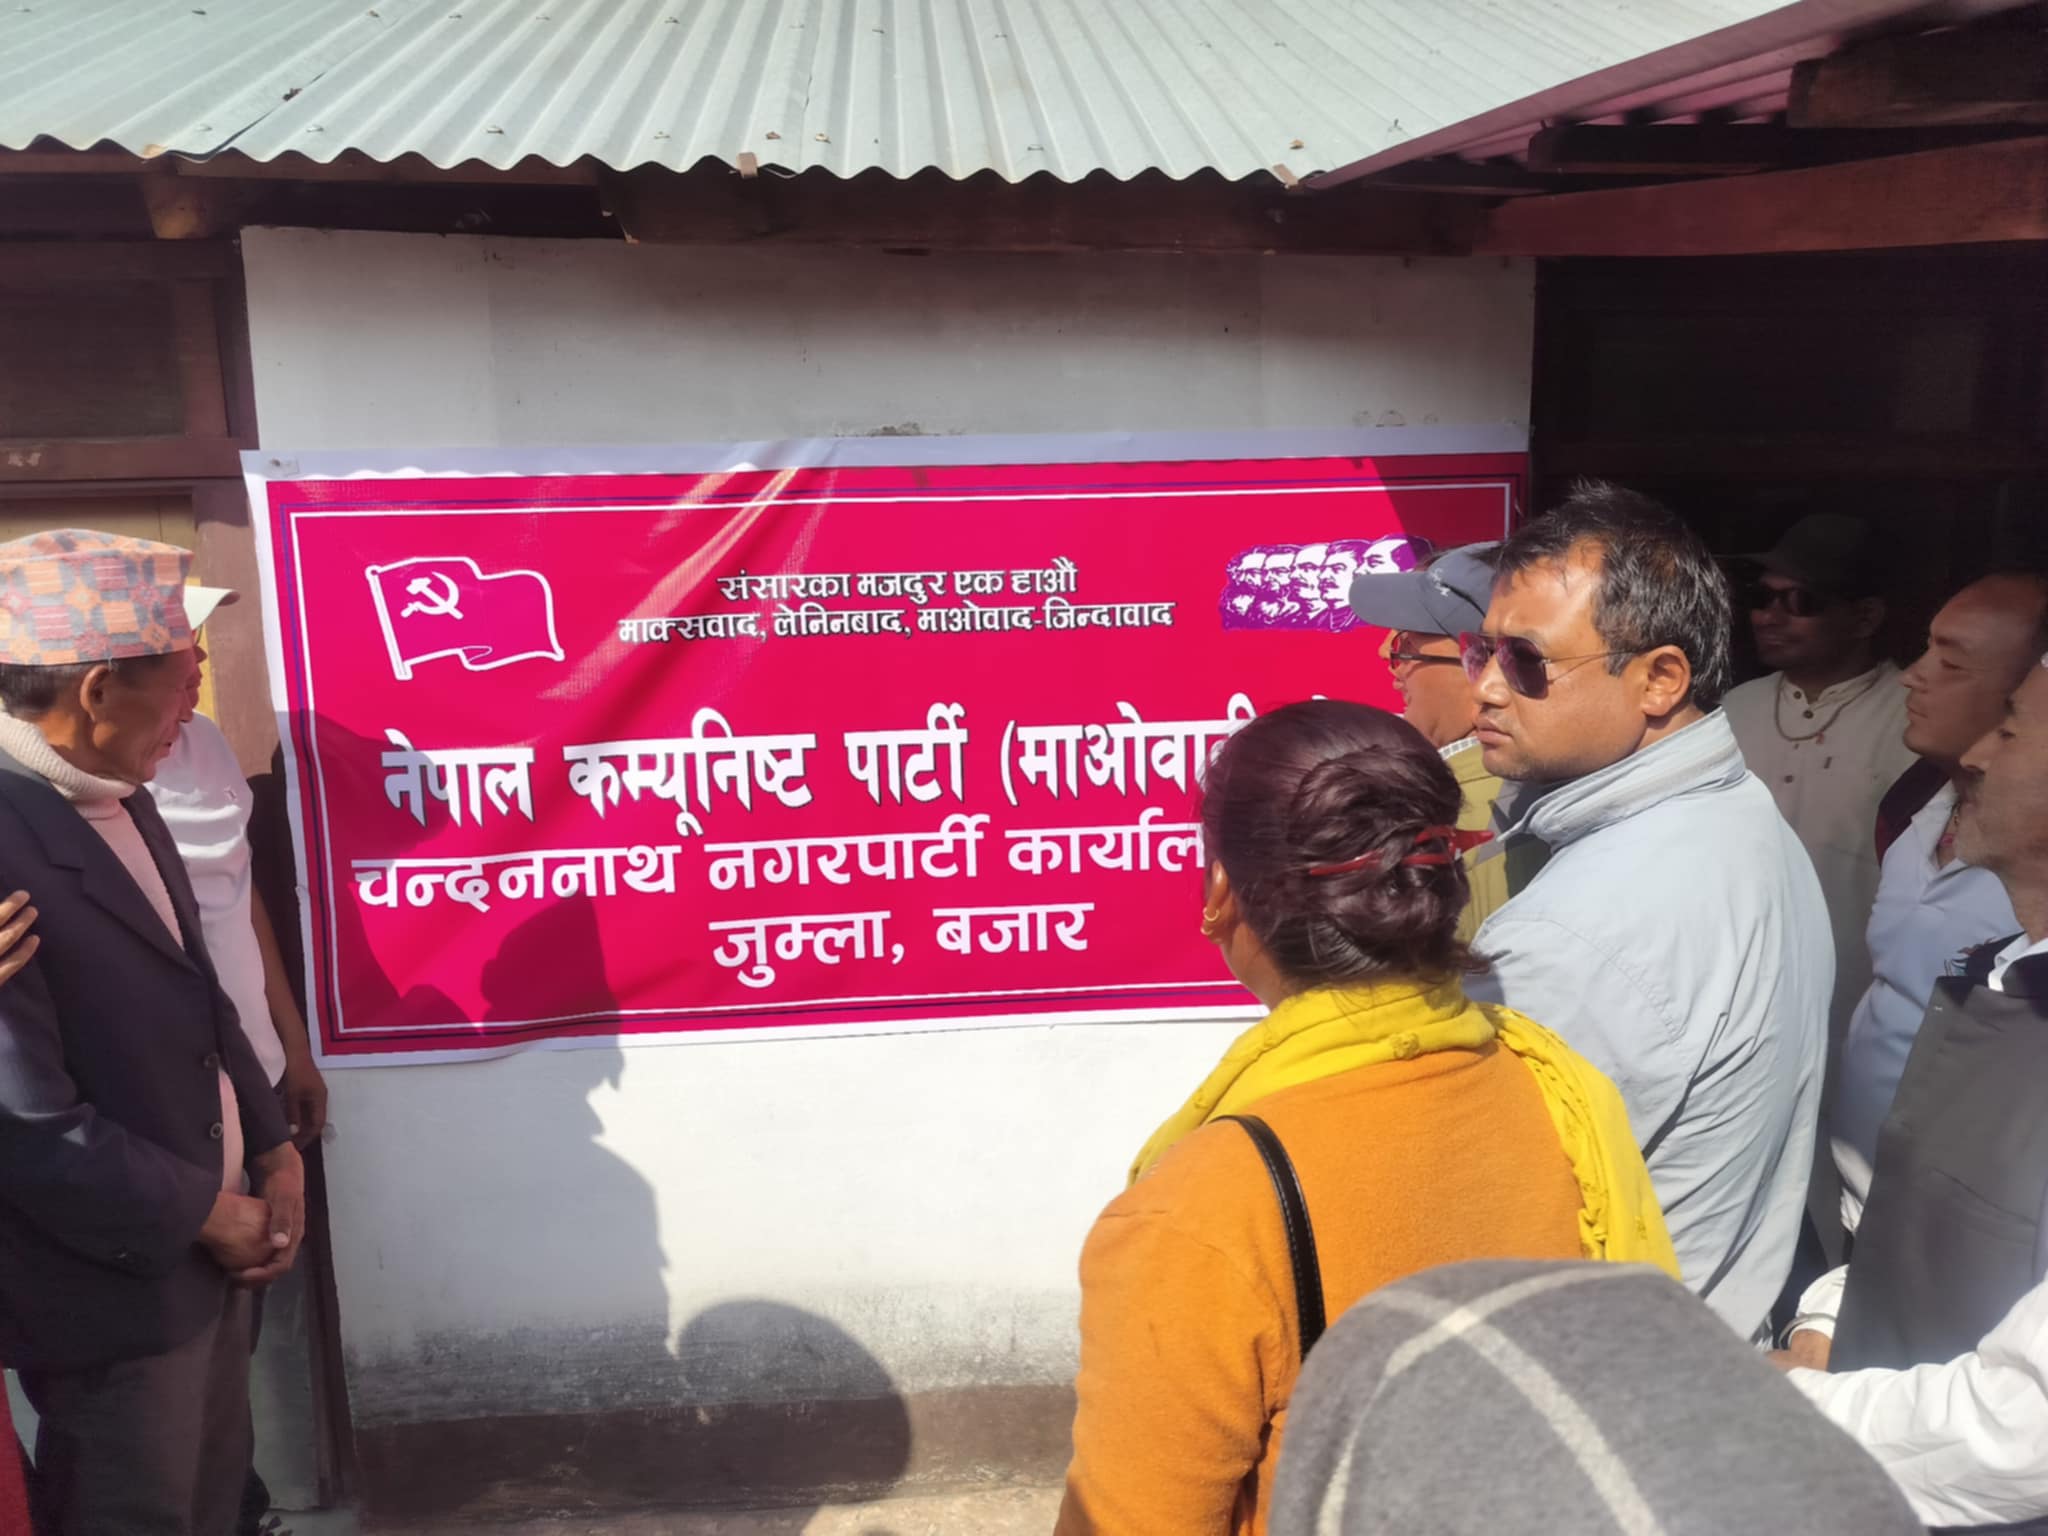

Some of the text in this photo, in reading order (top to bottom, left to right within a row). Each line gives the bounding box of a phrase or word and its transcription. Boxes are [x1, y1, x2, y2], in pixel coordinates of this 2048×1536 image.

[717, 569, 852, 601] संसारका
[856, 571, 948, 605] मजदुर
[952, 569, 1006, 596] एक
[381, 729, 535, 827] नेपाल
[563, 707, 817, 837] कम्यूनिष्ट
[844, 702, 968, 805] पार्टी
[351, 844, 682, 913] चन्दननाथ
[1005, 806, 1205, 876] कार्याल
[708, 902, 1095, 988] जुम्ला, बजार
